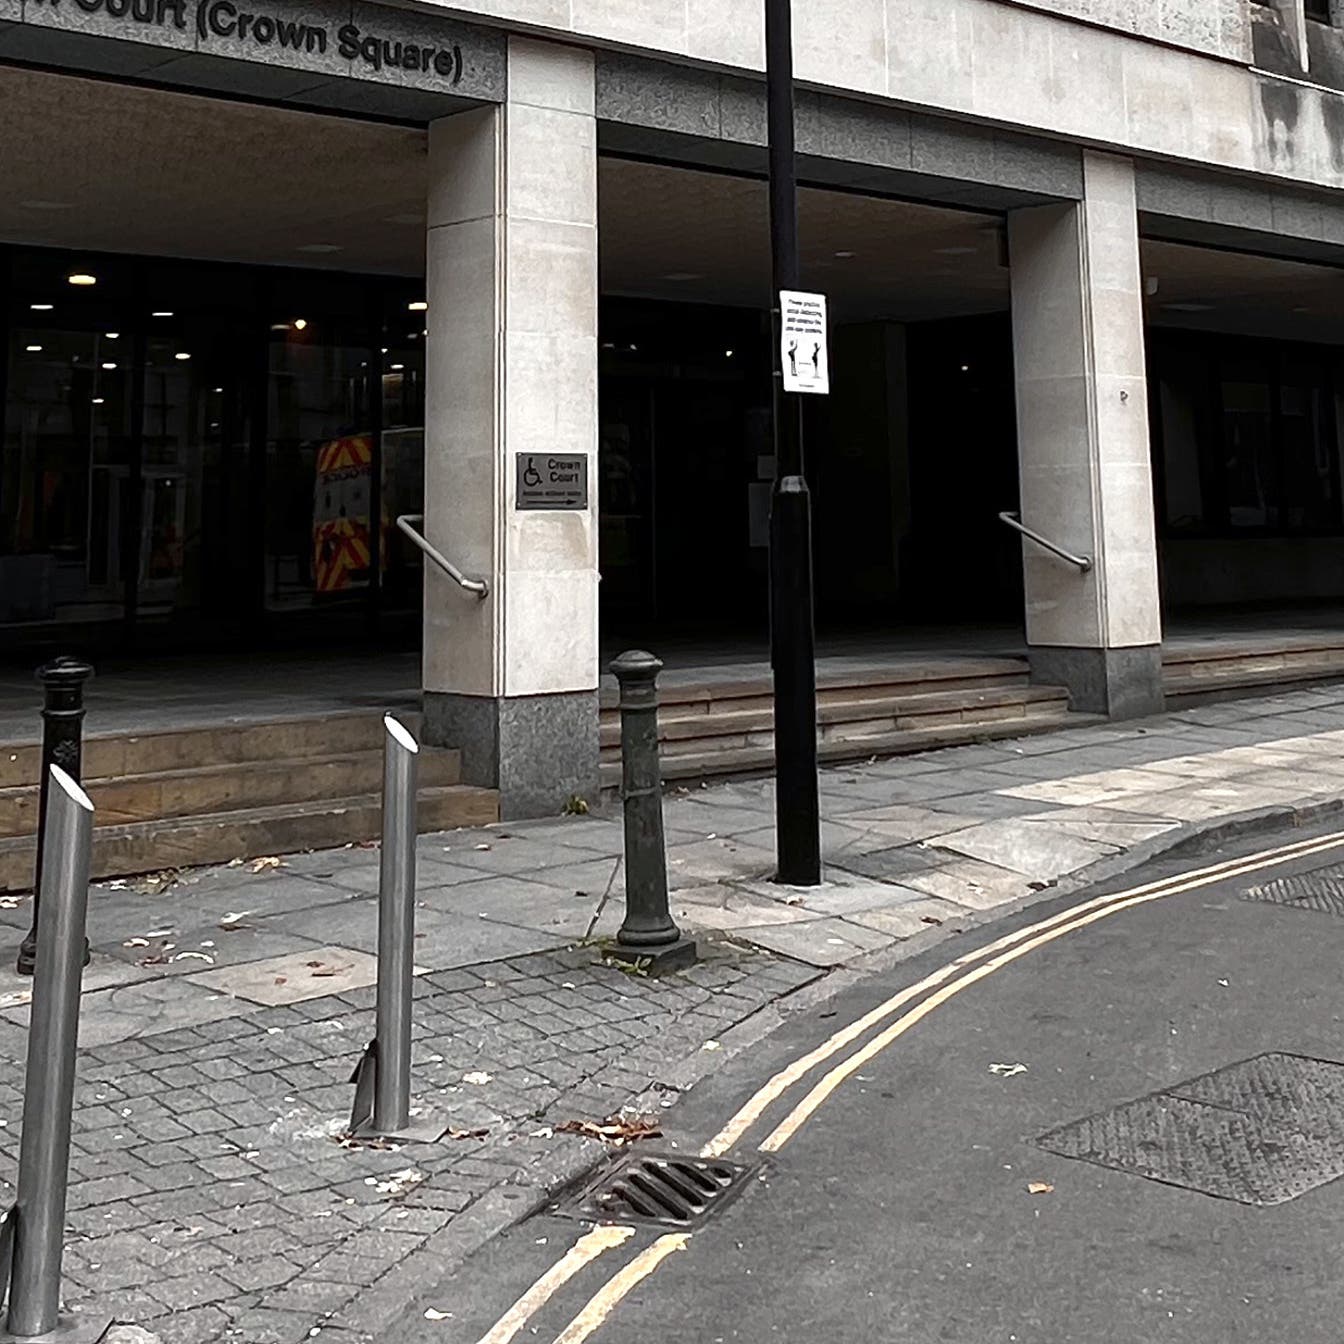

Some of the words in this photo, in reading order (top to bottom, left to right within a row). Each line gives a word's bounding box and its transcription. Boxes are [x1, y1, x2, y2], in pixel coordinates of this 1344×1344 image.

[337, 24, 463, 86] Square)
[548, 457, 581, 470] Crown
[550, 471, 579, 483] Court
